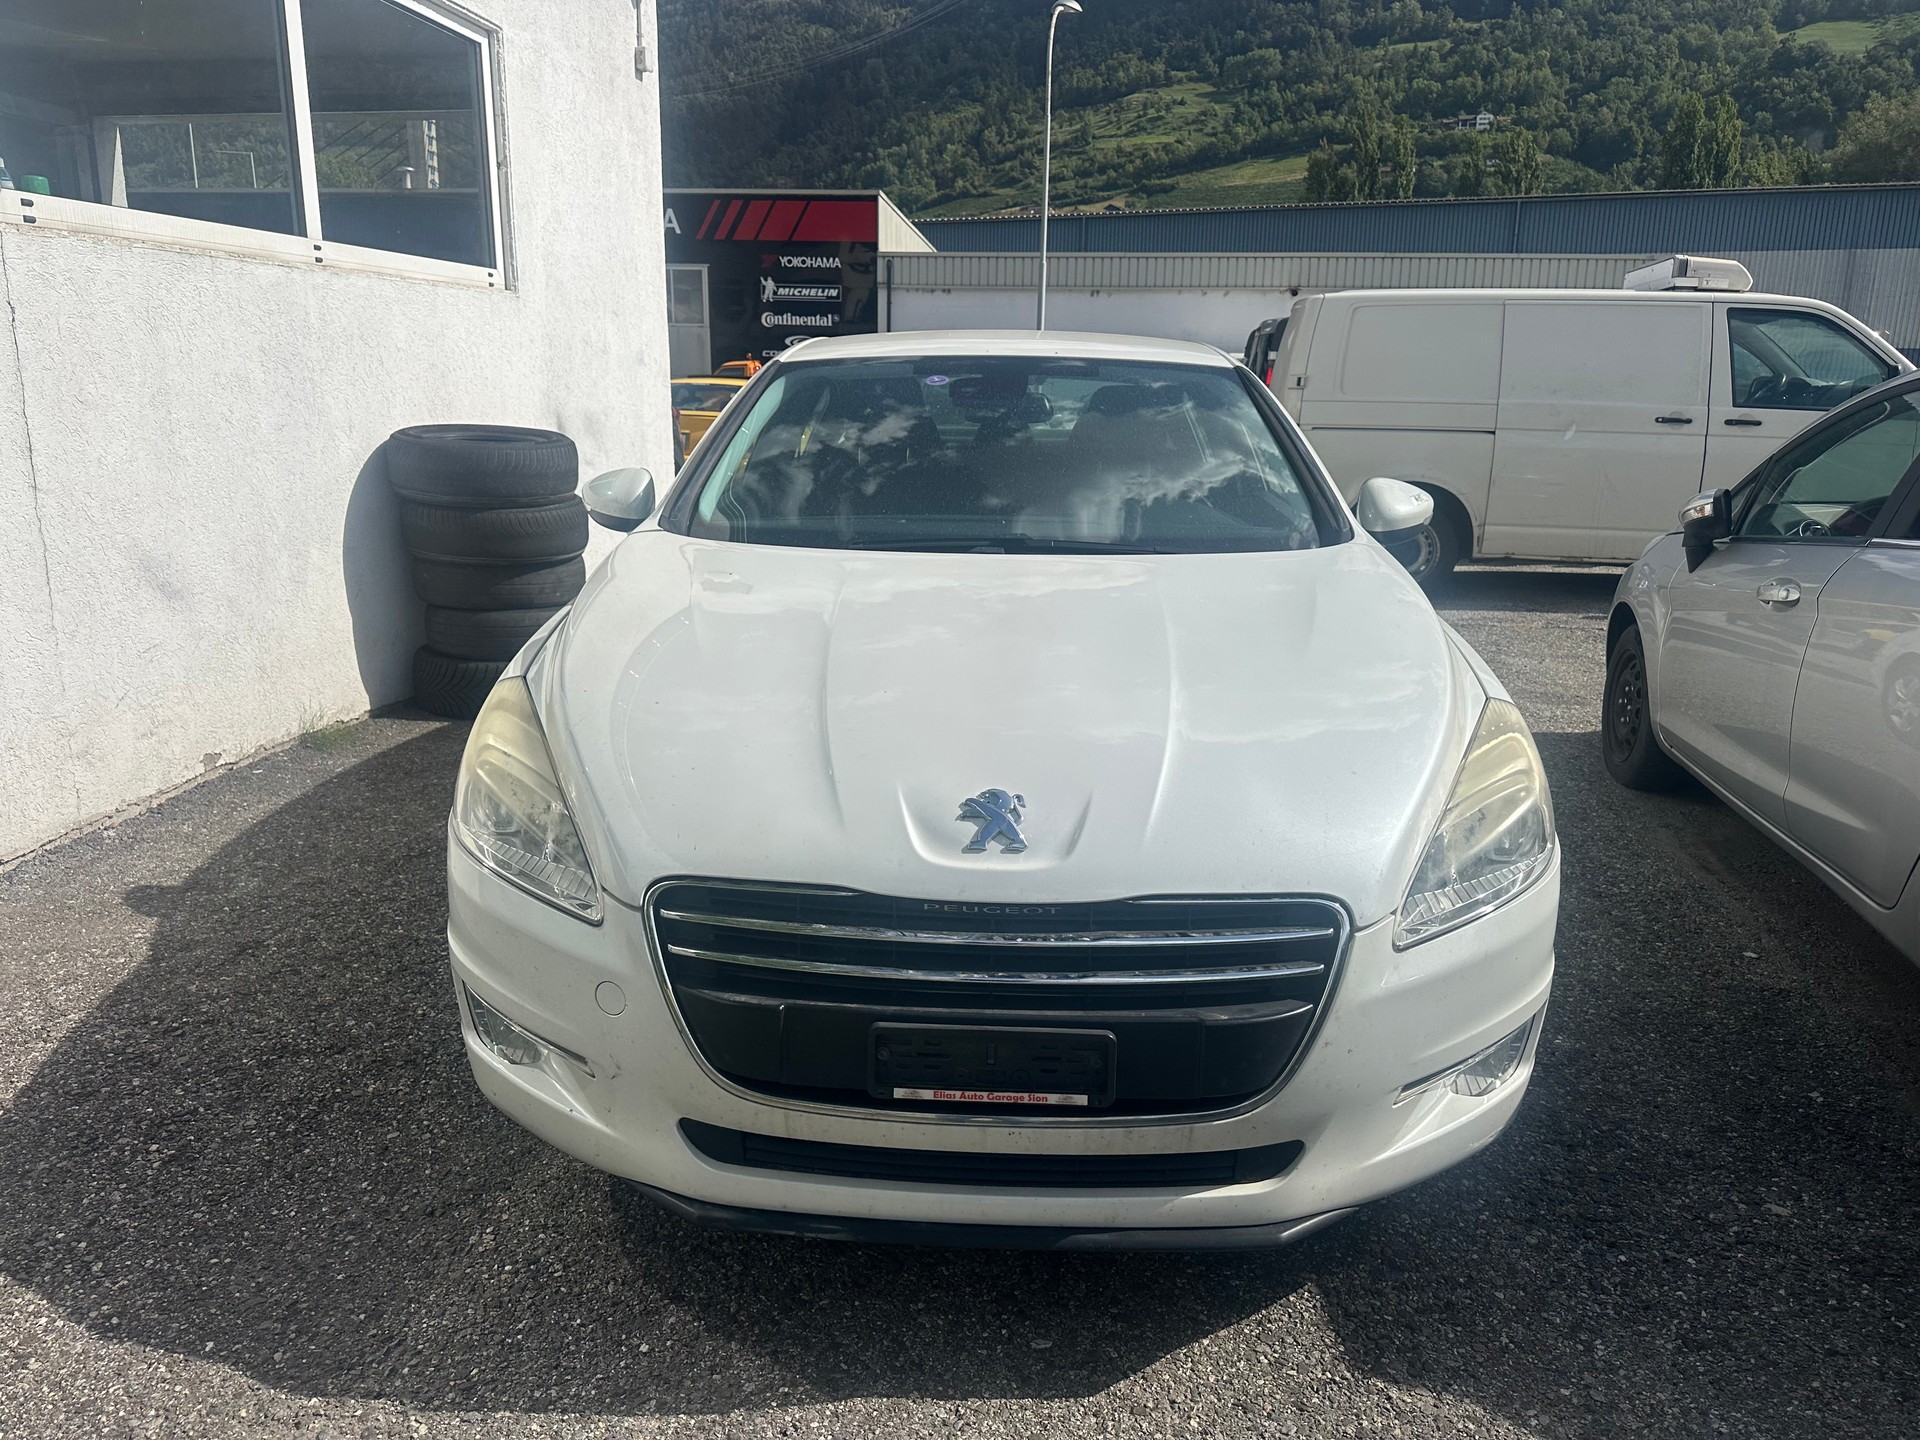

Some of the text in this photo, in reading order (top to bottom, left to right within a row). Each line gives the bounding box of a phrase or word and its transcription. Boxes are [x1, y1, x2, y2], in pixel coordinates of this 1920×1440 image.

[779, 255, 842, 269] YOKOHAMA
[777, 287, 838, 297] MICHELIN
[760, 311, 833, 328] Continental
[923, 903, 1062, 915] PEUGEOT
[933, 1090, 956, 1099] Elias
[959, 1091, 984, 1101] Auto
[987, 1092, 1025, 1104] Garage
[1027, 1093, 1048, 1103] Sion
